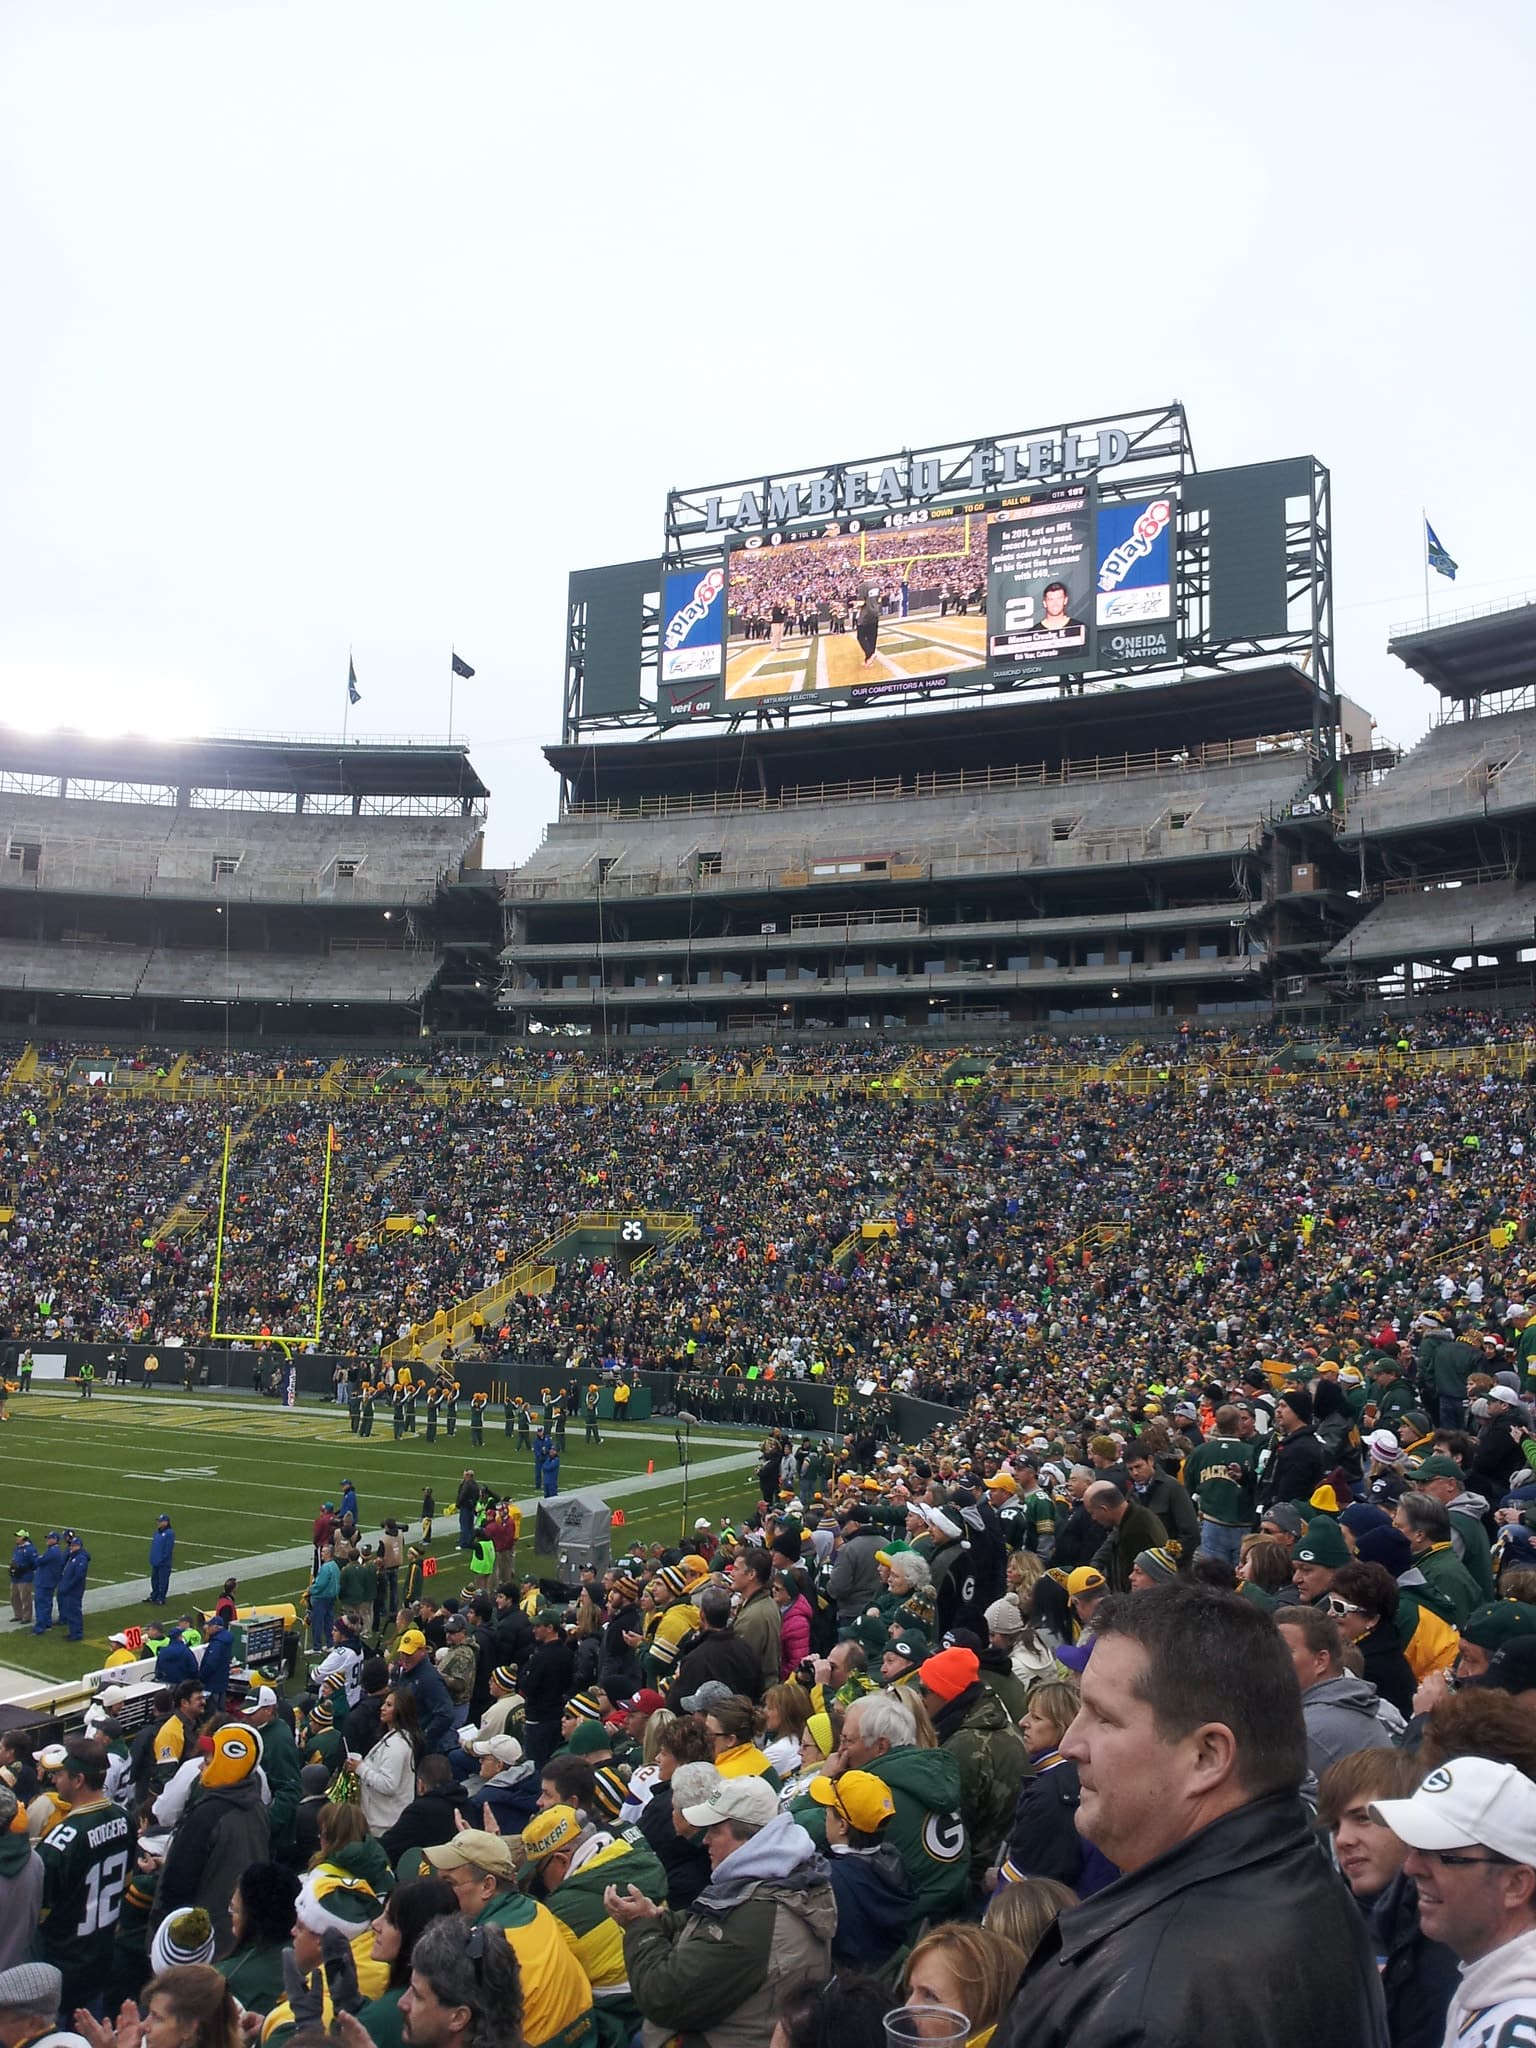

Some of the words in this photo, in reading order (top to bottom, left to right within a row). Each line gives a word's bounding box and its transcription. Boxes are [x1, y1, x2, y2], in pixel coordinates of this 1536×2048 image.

[705, 459, 941, 532] LAMBEAU
[969, 428, 1130, 489] FIELD
[964, 504, 972, 512] TO
[973, 503, 985, 512] GO
[1001, 497, 1019, 506] BALL
[883, 509, 929, 528] 16:43
[930, 508, 955, 518] DOWN
[849, 520, 860, 533] 0
[1002, 531, 1010, 540] In
[1031, 527, 1044, 536] set
[1056, 522, 1073, 532] NFL
[771, 532, 782, 546] 0
[1001, 541, 1026, 551] record
[1027, 539, 1038, 547] for
[1039, 536, 1052, 545] the
[1053, 533, 1073, 543] most
[991, 552, 1015, 565] points
[1016, 549, 1041, 559] scored
[1042, 547, 1052, 557] by
[1059, 543, 1083, 555] player
[1003, 562, 1015, 572] his
[1016, 560, 1032, 570] first
[1033, 559, 1047, 568] five
[1048, 555, 1080, 565] seasons
[1014, 570, 1031, 581] with
[1005, 596, 1034, 631] 2
[1111, 633, 1166, 650] ONEIDA
[1125, 646, 1167, 659] NATION
[993, 669, 1021, 677] DIAMOND
[1023, 666, 1042, 674] VISION
[852, 687, 868, 697] OUR
[869, 682, 918, 695] COMPETITORS
[925, 679, 947, 688] HAND
[670, 701, 711, 714] verizon
[622, 1221, 642, 1240] 25
[1300, 1550, 1314, 1561] G
[962, 1576, 975, 1601] G
[126, 1629, 142, 1648] 30
[222, 1740, 248, 1759] G
[1422, 1768, 1452, 1793] G
[43, 1823, 78, 1852] 12
[87, 1817, 128, 1849] RODGERS
[526, 1818, 569, 1854] PACKERS
[923, 1811, 966, 1861] G
[77, 1850, 128, 1936] 12
